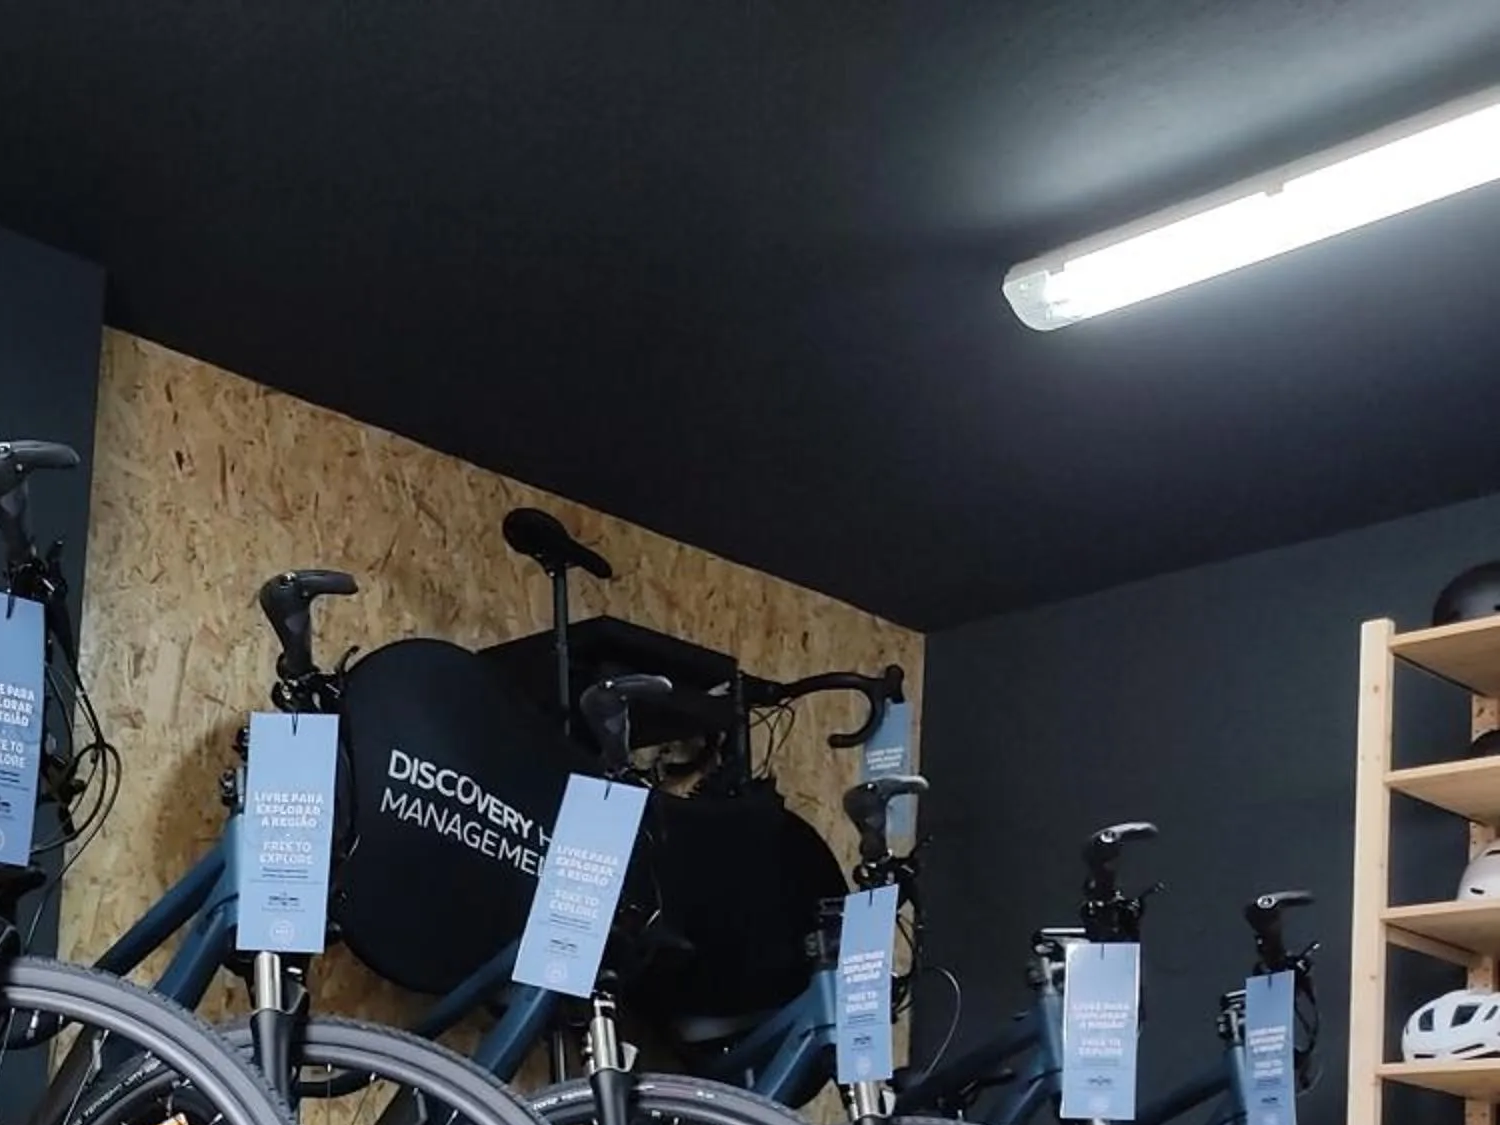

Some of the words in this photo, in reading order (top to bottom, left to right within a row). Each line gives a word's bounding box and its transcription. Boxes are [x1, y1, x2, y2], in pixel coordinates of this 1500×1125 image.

[7, 684, 35, 701] PARA
[11, 741, 24, 754] TO
[388, 749, 533, 840] DISCOVERY
